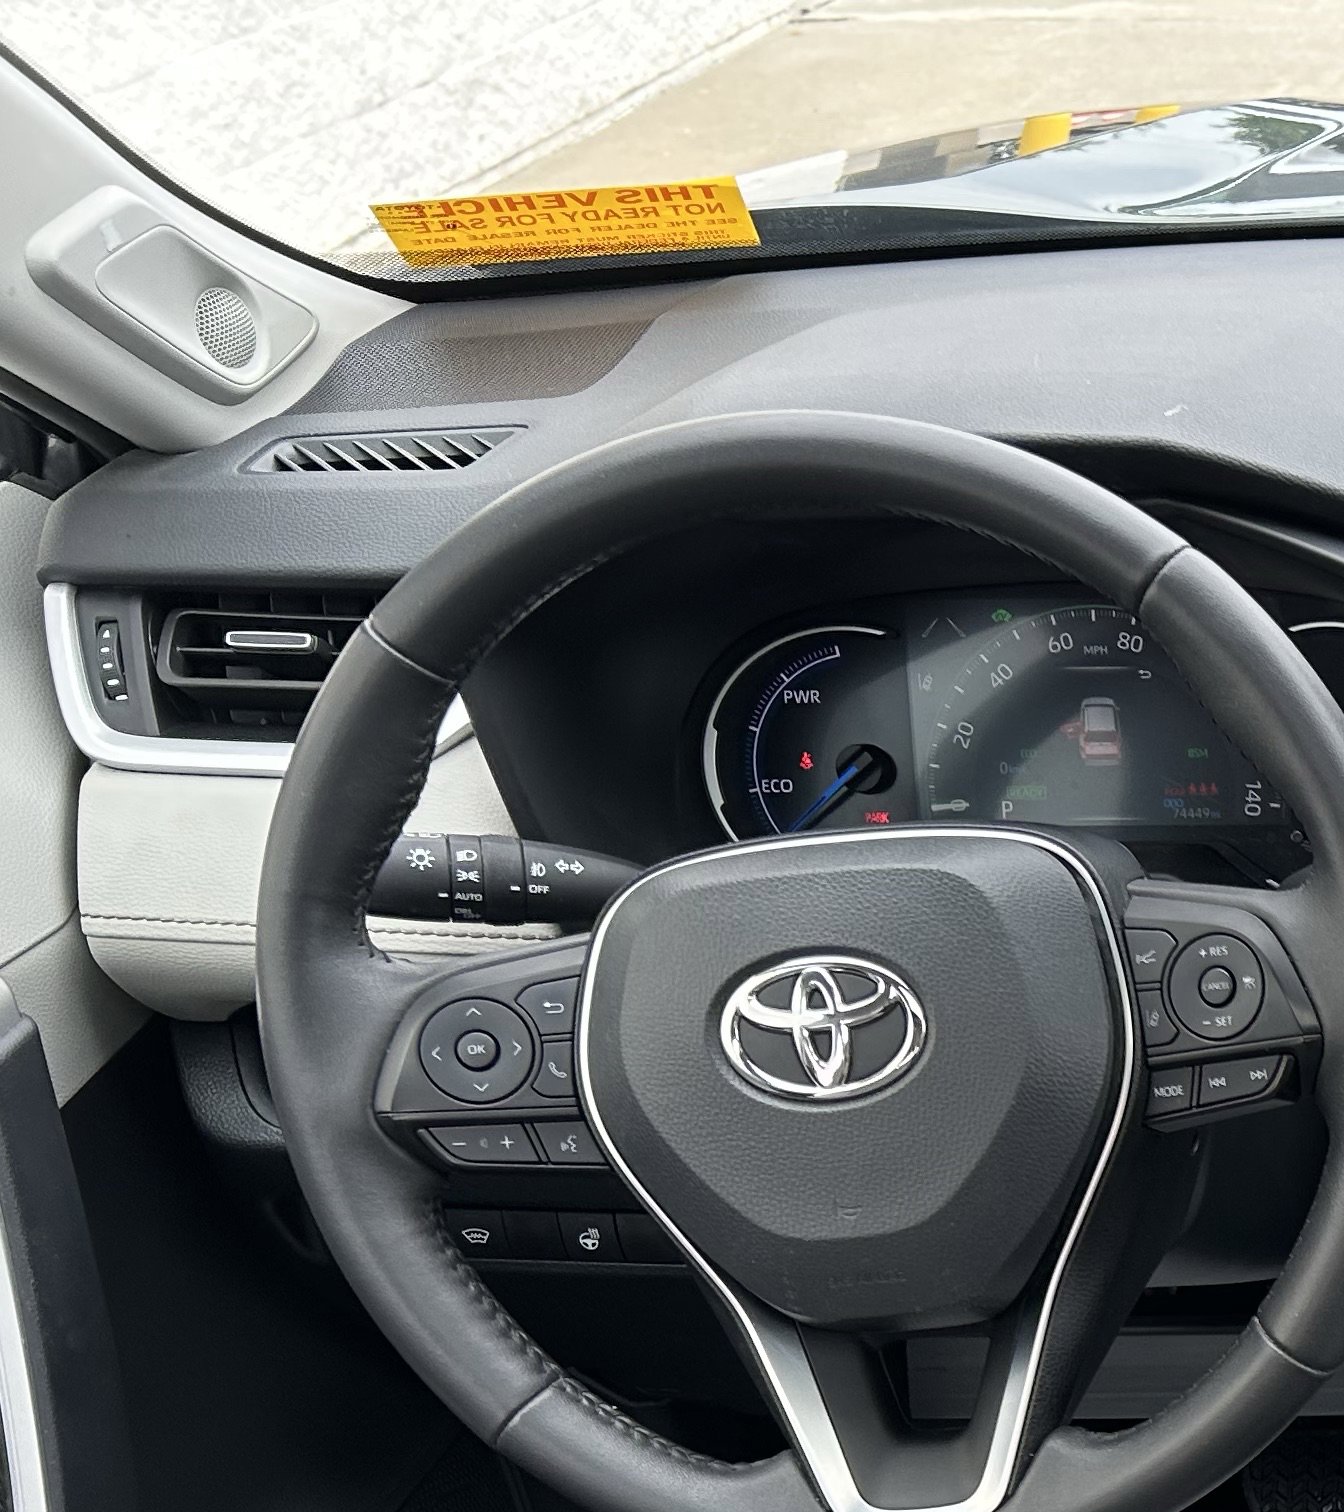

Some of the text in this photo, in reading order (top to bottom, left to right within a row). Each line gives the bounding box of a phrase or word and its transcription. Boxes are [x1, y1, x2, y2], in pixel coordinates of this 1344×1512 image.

[1047, 631, 1144, 654] 60 80
[1083, 644, 1109, 656] MPH
[989, 662, 1014, 690] 40
[784, 690, 821, 705] PWR
[952, 721, 975, 751] 20
[761, 778, 794, 794] ECO
[1243, 780, 1263, 818] 140
[1001, 800, 1014, 820] P
[1173, 807, 1210, 819] 74449
[454, 891, 483, 902] AUTO
[528, 884, 550, 895] OFF
[1209, 945, 1229, 957] RES
[1215, 1015, 1233, 1028] SET
[466, 1043, 486, 1055] OK
[1153, 1084, 1184, 1098] MODE
